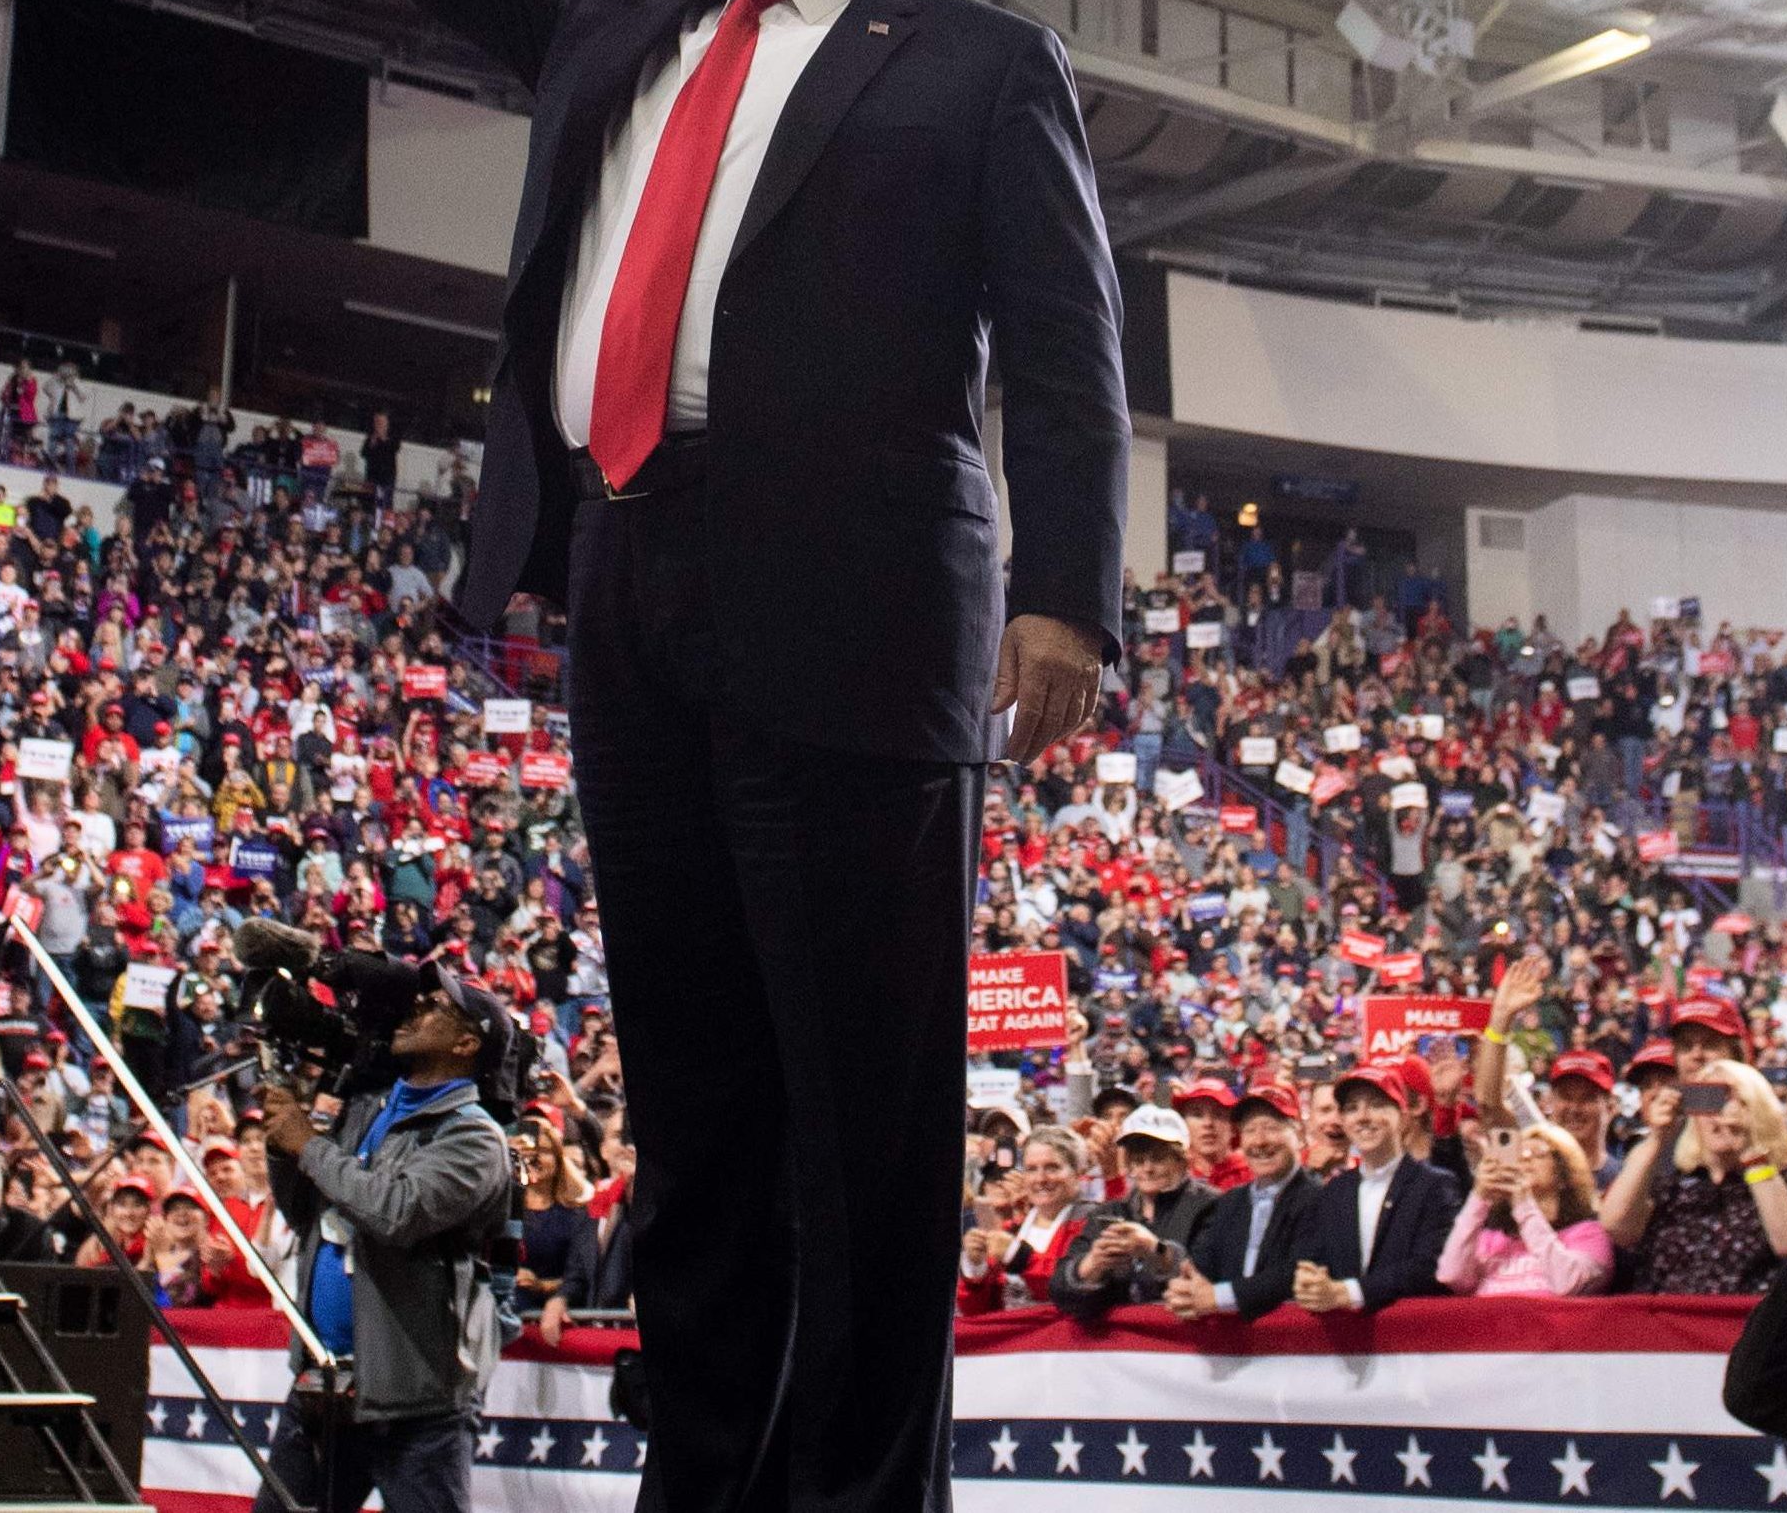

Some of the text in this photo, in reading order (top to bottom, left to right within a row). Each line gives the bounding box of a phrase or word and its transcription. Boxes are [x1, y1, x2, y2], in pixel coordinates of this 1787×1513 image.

[971, 967, 1026, 985] MAKE
[967, 986, 1062, 1013] MERICA
[967, 1012, 1065, 1033] EAT AGAIN
[1404, 1010, 1462, 1028] MAKE
